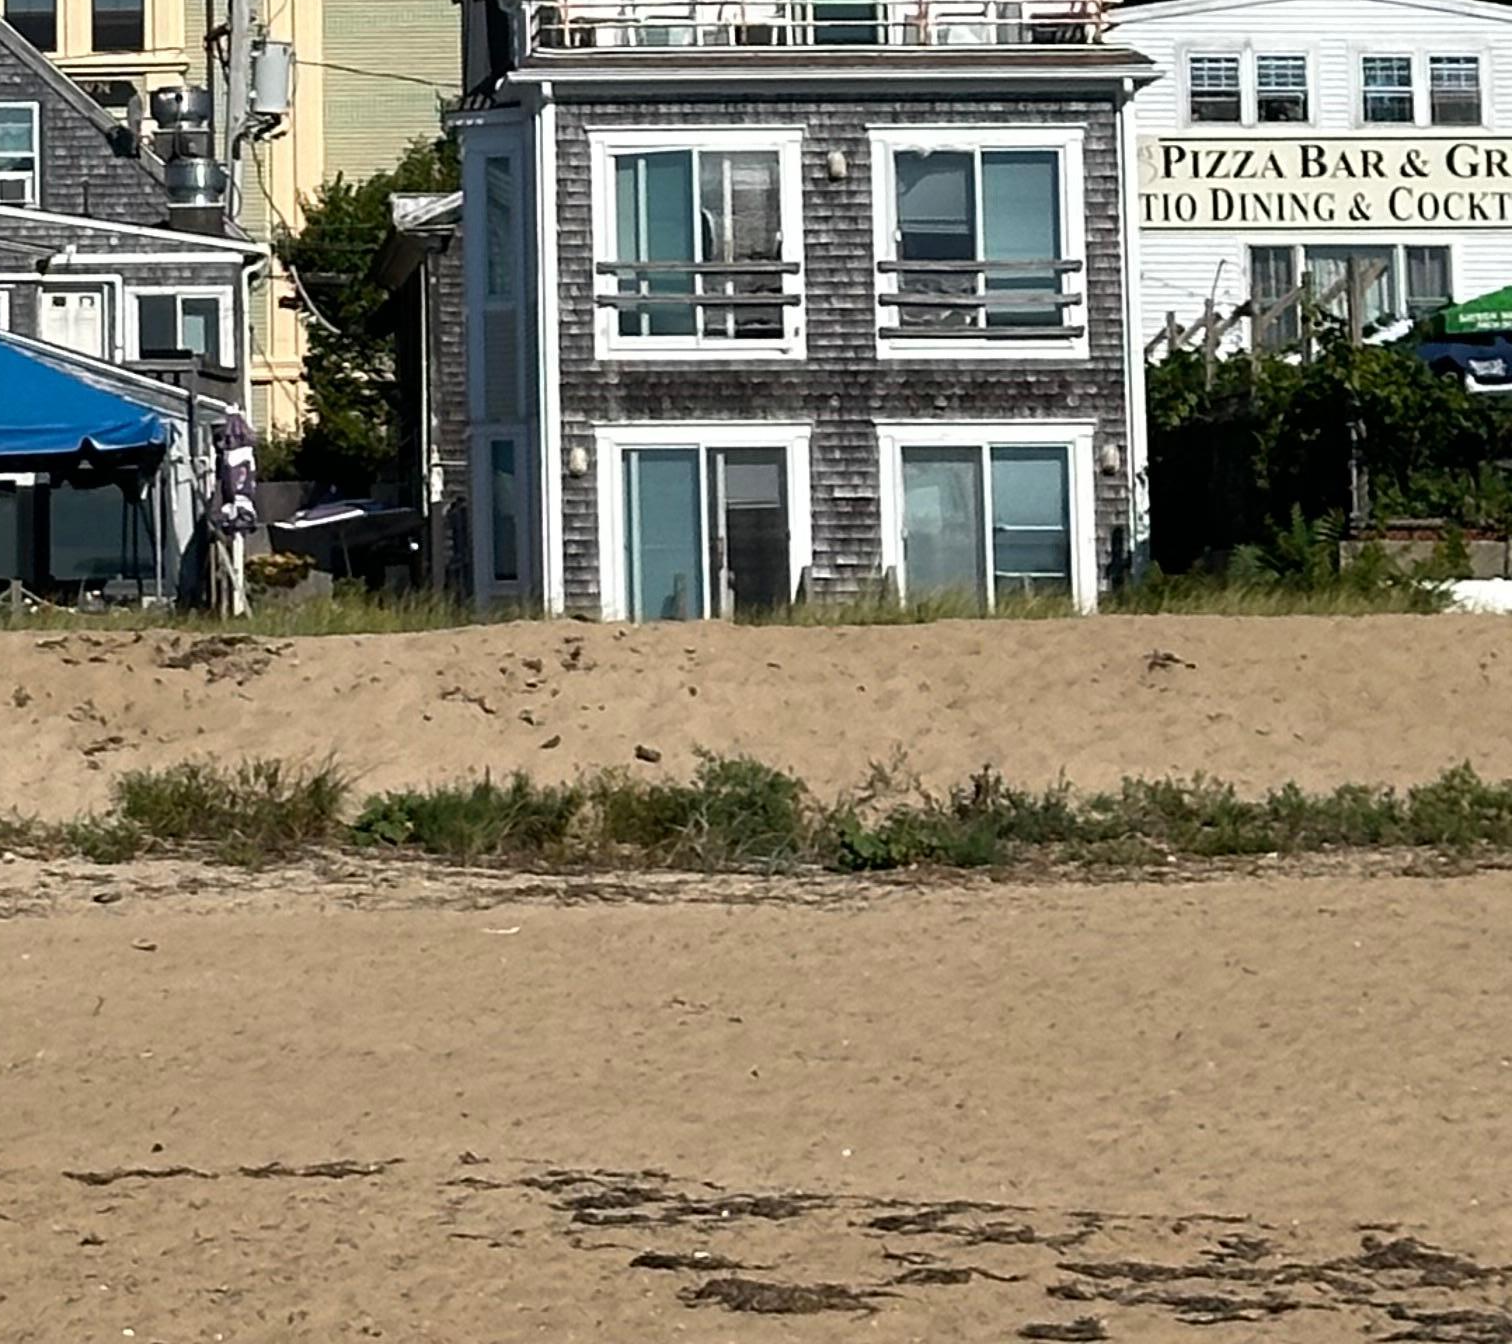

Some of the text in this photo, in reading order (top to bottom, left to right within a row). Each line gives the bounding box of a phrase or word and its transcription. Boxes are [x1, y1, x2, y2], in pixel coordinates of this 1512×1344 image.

[1160, 144, 1287, 179] PIZZA
[1298, 144, 1389, 179] BAR
[1399, 148, 1431, 179] &
[1445, 143, 1512, 179] GR
[1138, 186, 1512, 222] TIO DINING & COCKT
